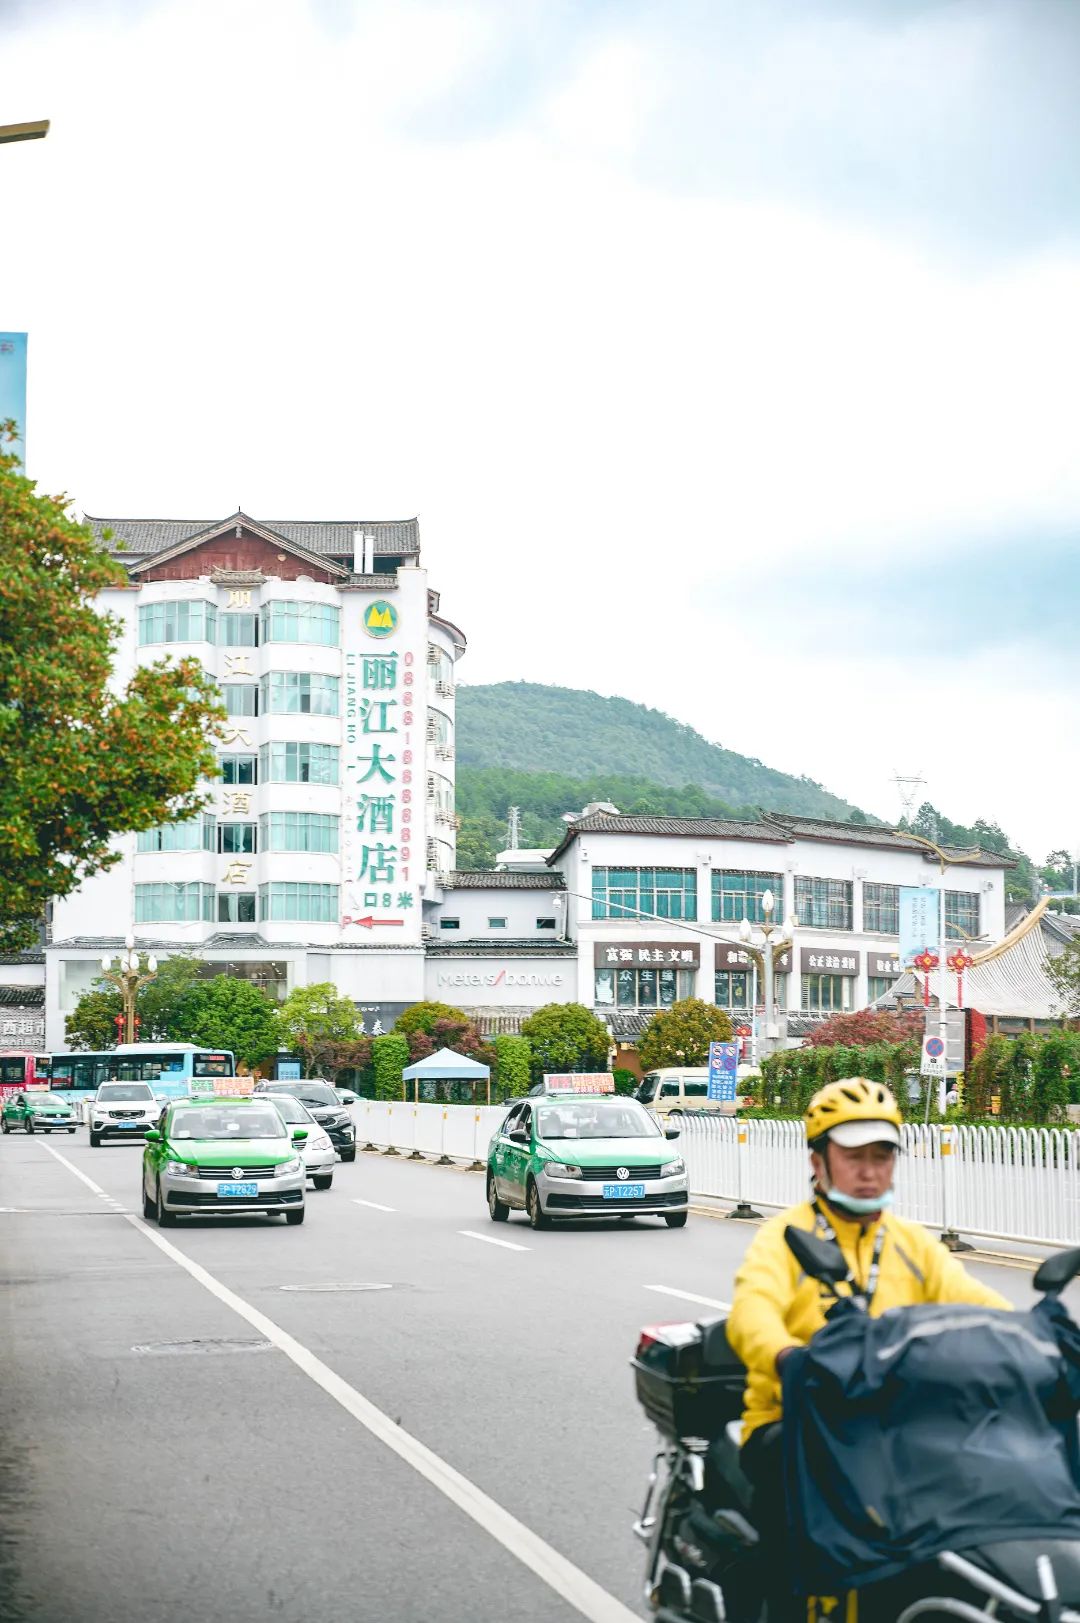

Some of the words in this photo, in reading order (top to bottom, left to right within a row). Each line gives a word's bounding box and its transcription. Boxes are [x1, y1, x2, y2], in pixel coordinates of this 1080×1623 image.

[222, 586, 256, 884] 丽江大酒店
[346, 675, 356, 718] JIANG
[356, 650, 399, 885] 丽江大酒店
[605, 947, 633, 962] 富强
[638, 948, 665, 962] 民主
[668, 948, 694, 963] 文明
